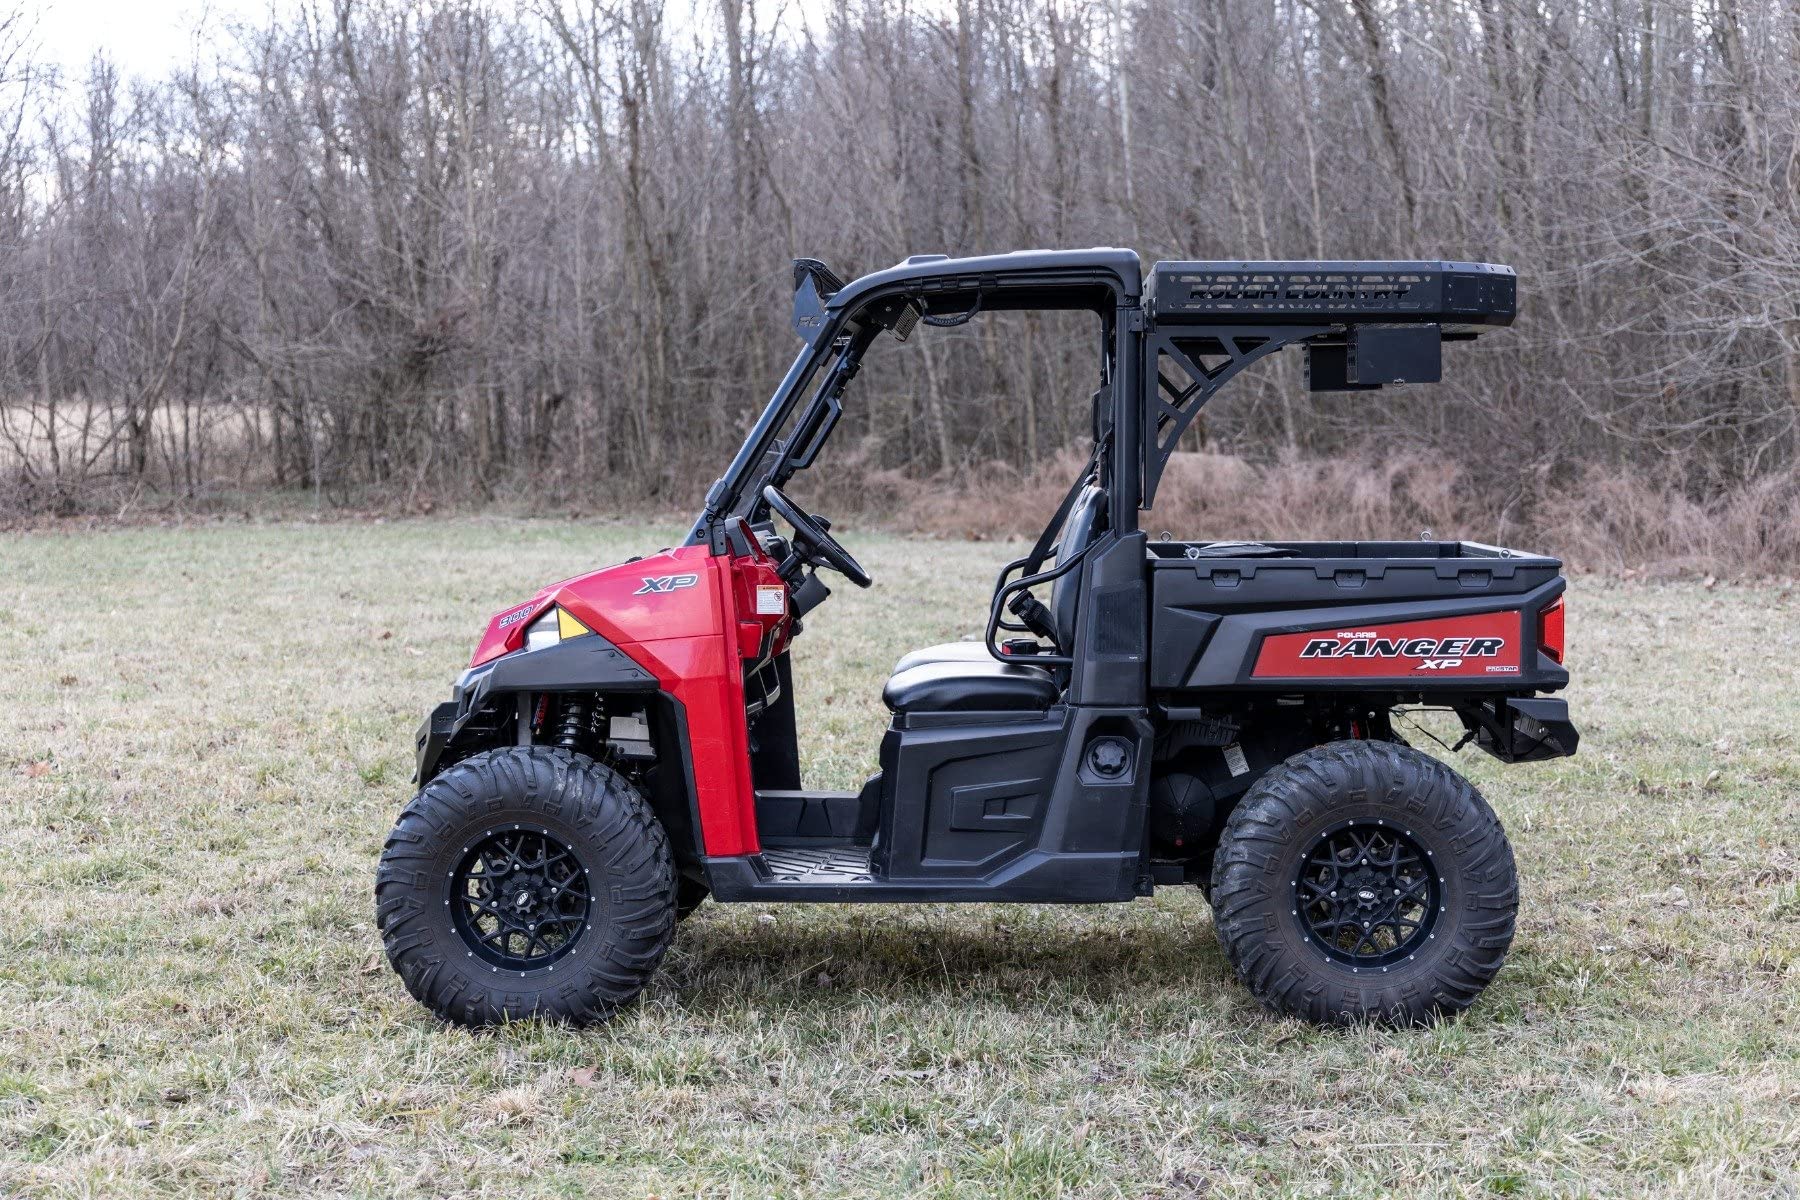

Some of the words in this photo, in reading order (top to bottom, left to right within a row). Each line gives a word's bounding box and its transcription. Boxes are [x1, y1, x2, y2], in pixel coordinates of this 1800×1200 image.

[1189, 284, 1280, 300] ROUGH
[1285, 284, 1411, 300] COUNTRY
[632, 573, 699, 595] XP
[498, 604, 534, 629] 900
[1336, 631, 1377, 639] POLARIS
[1299, 637, 1505, 658] RANGER
[1415, 659, 1463, 670] XP
